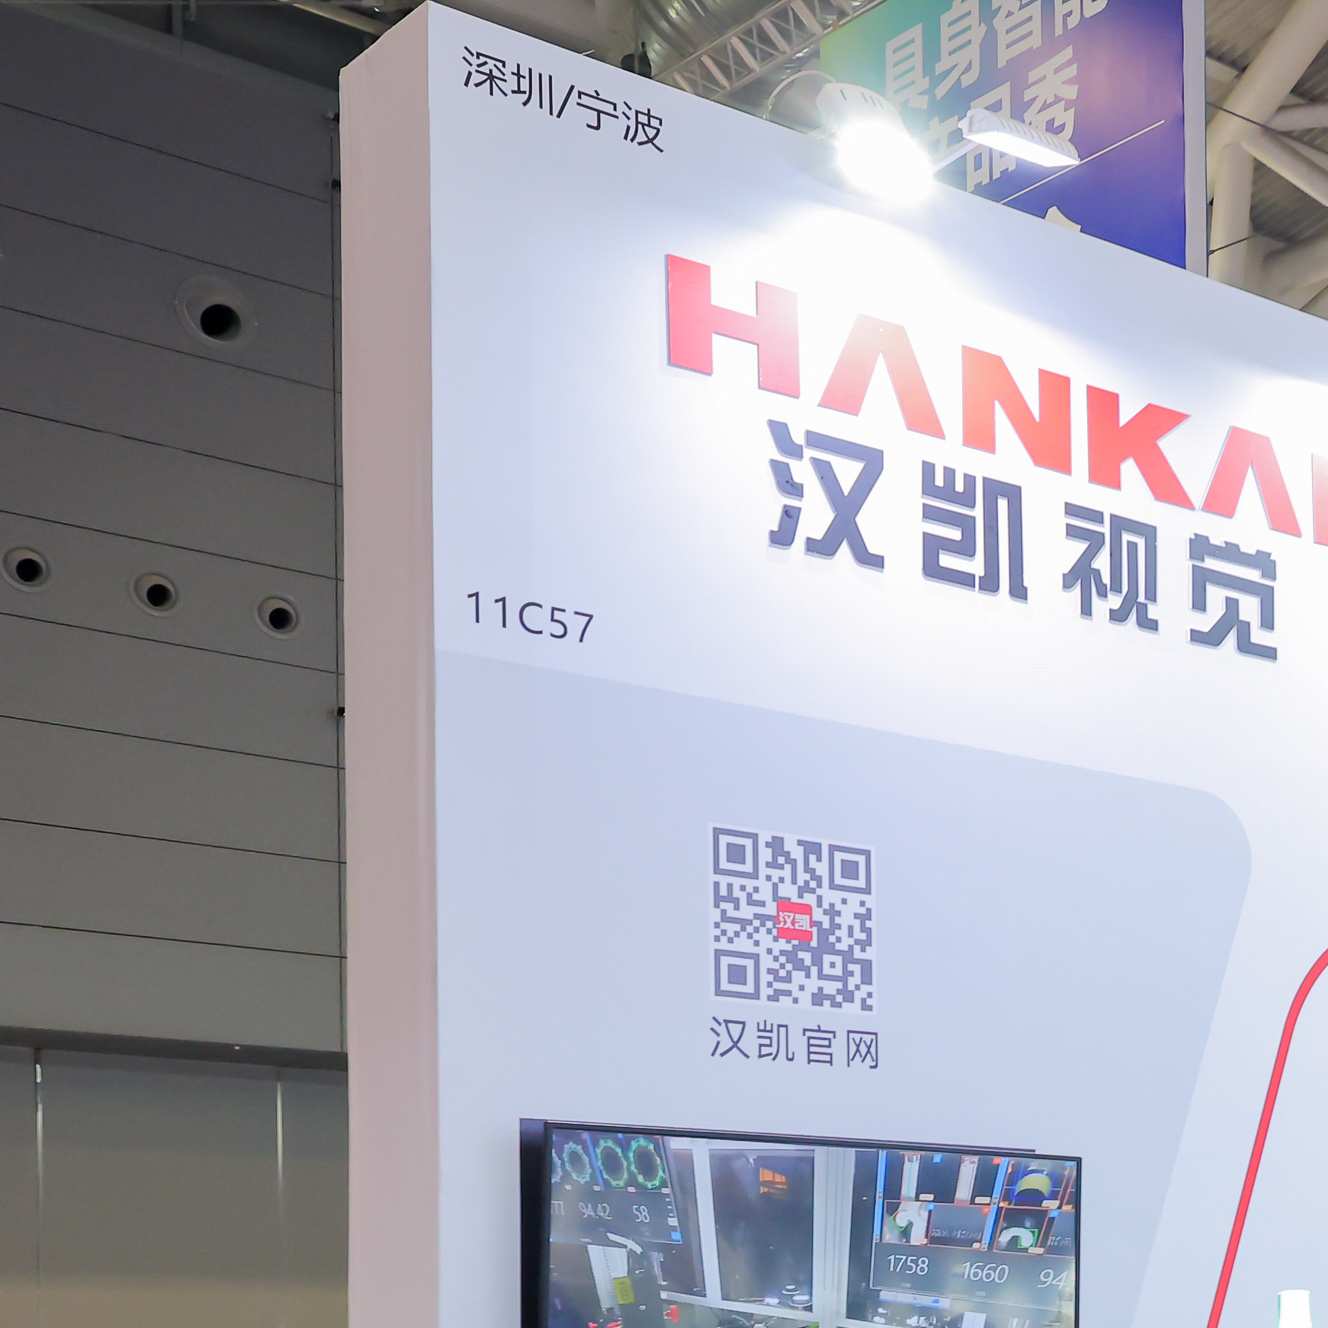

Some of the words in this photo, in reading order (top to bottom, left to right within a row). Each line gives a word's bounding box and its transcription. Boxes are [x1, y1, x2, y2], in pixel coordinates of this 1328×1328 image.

[460, 44, 666, 153] 深圳/宁波
[767, 419, 1278, 662] 汉凯视觉
[466, 591, 595, 645] 11C57
[709, 1016, 879, 1070] 汉凯官网
[887, 1254, 929, 1275] 1758
[961, 1261, 1009, 1283] 1660
